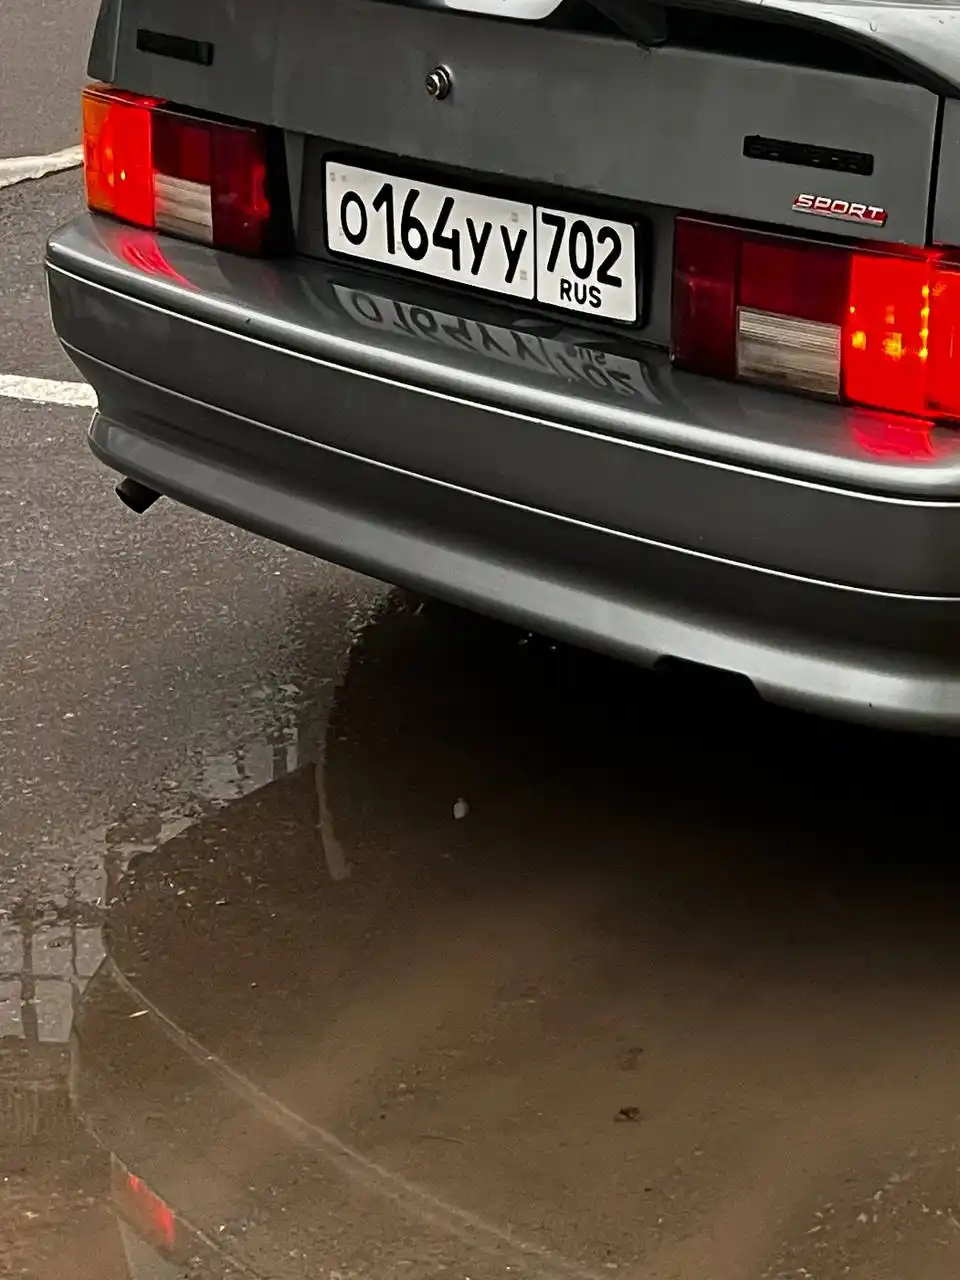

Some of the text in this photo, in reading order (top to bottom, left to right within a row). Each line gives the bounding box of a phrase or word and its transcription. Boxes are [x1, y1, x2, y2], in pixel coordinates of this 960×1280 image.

[796, 193, 884, 220] SPORT
[339, 182, 623, 288] О164УУ 702
[560, 278, 602, 309] RUS
